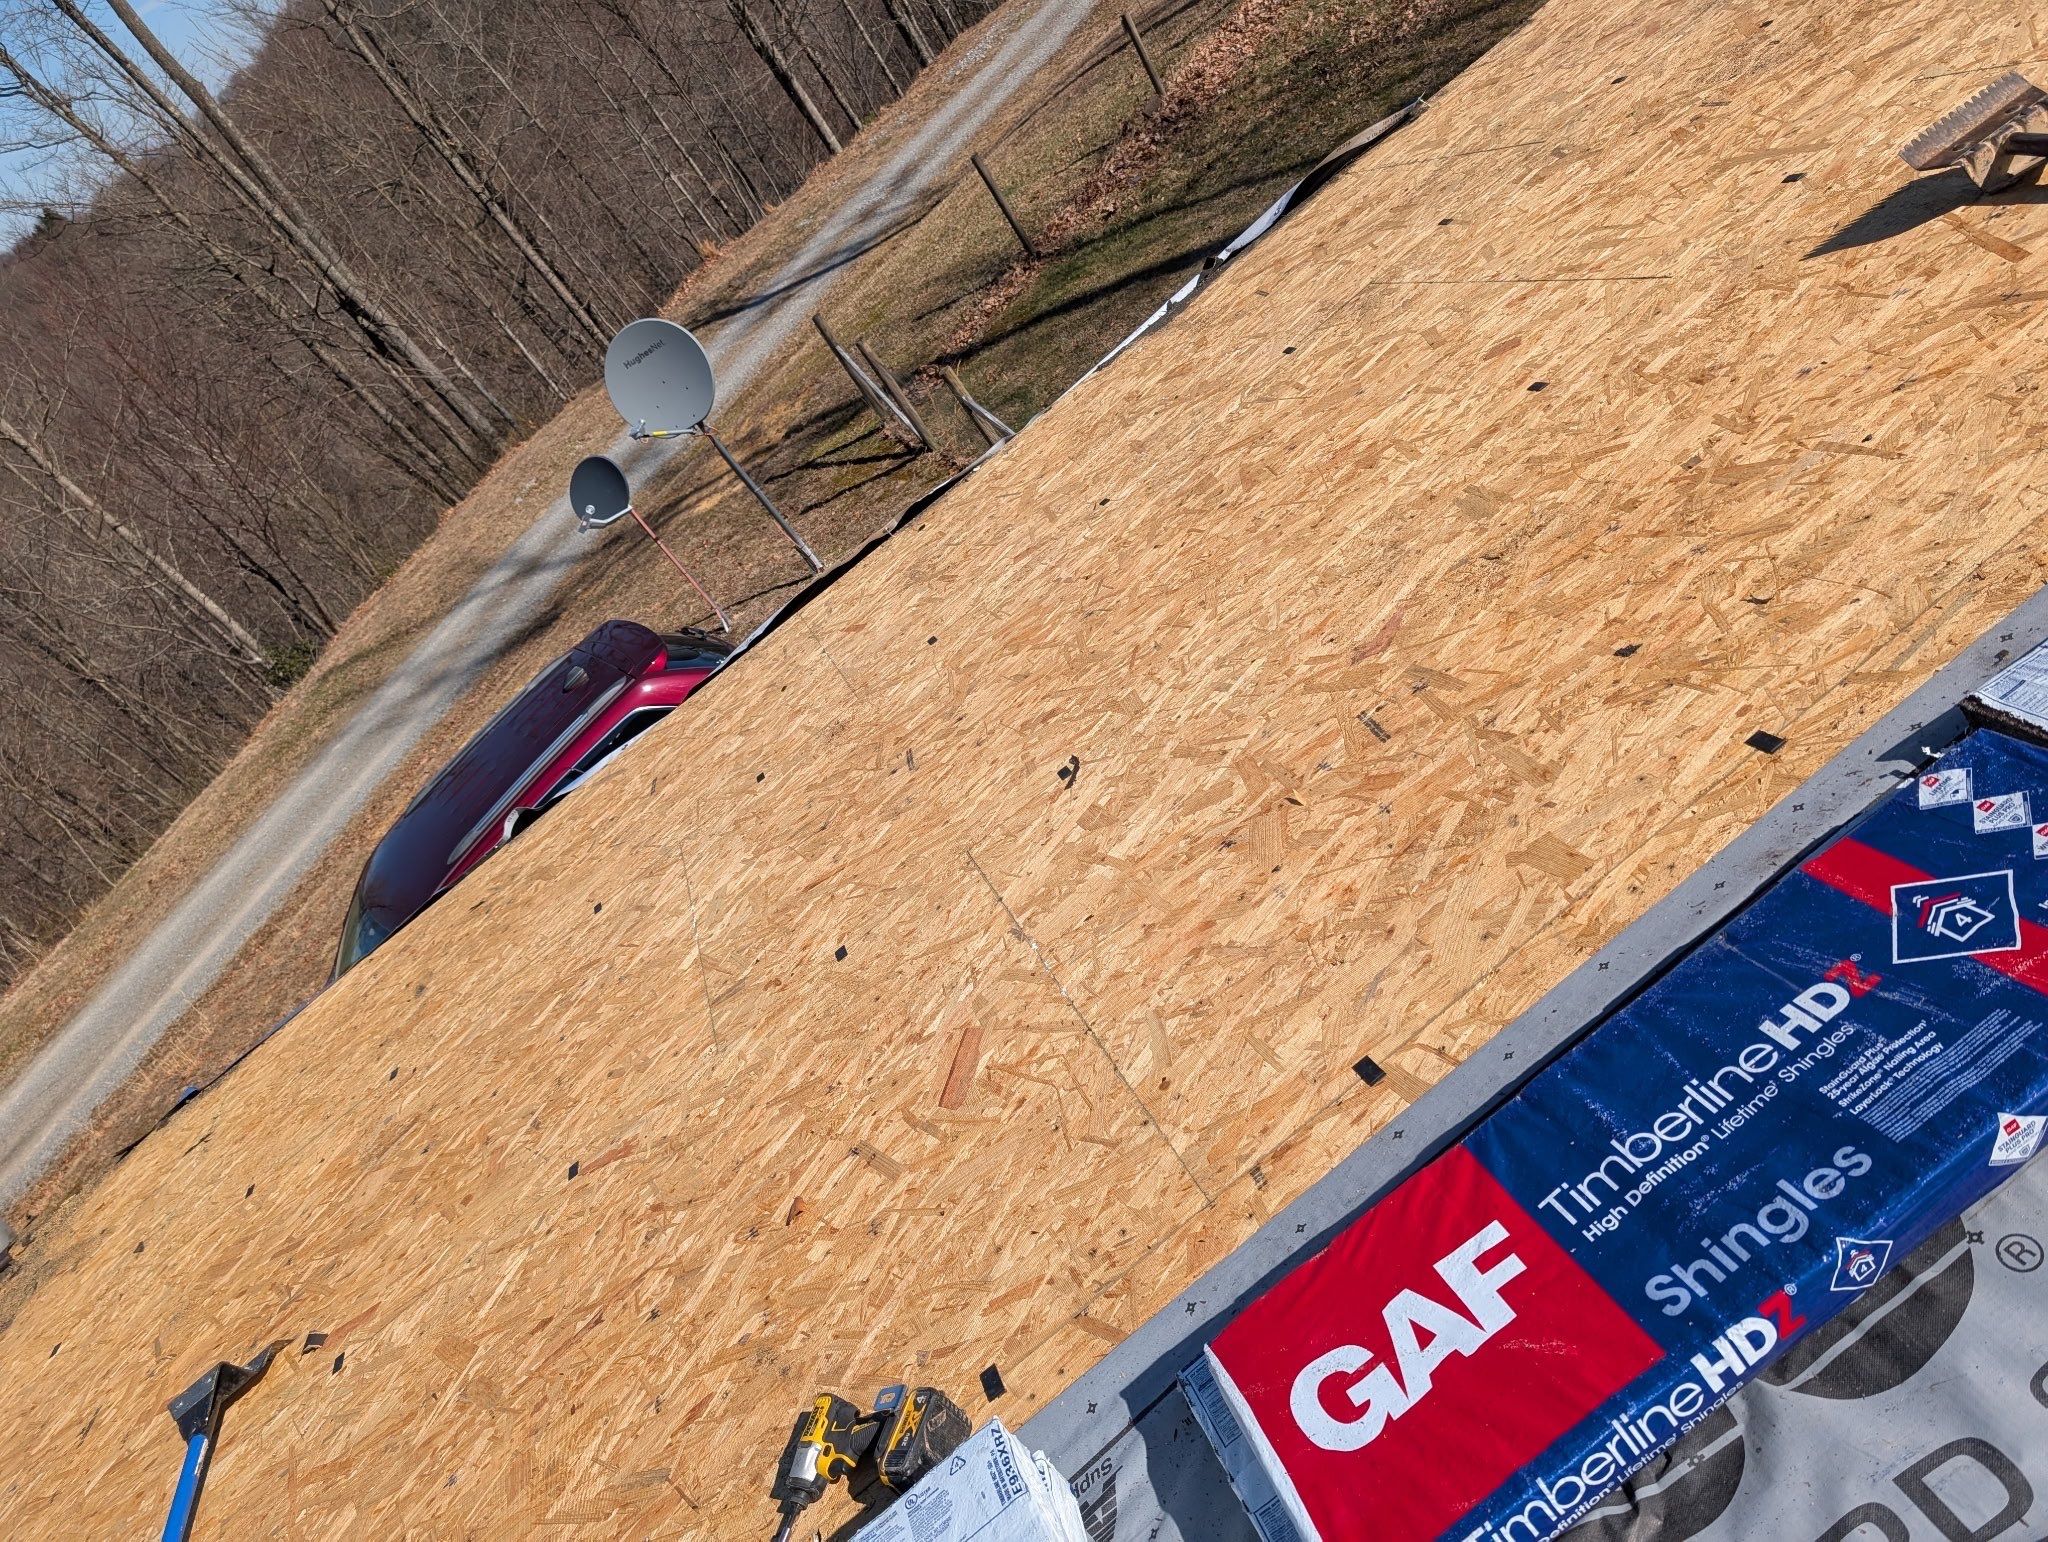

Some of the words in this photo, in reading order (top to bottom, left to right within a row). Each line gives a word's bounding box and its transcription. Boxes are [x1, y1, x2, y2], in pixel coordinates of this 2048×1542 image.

[623, 339, 665, 369] HughesNet
[1954, 912, 1972, 928] 4
[1883, 1046, 1917, 1071] Nailing
[1914, 1031, 1937, 1049] Area
[1893, 1042, 1944, 1079] Technology
[1819, 1055, 1867, 1094] StainGuard
[1827, 1074, 1860, 1100] 25-year
[1859, 1052, 1885, 1076] Algae
[1582, 1204, 1628, 1242] High
[1778, 1025, 1854, 1083] Shingles
[1998, 1120, 2036, 1152] STAINGUARD
[2005, 1140, 2021, 1154] PLUS
[2021, 1129, 2035, 1140] PRO
[1645, 1145, 1873, 1316] Shingles
[1290, 1219, 1528, 1452] GAF
